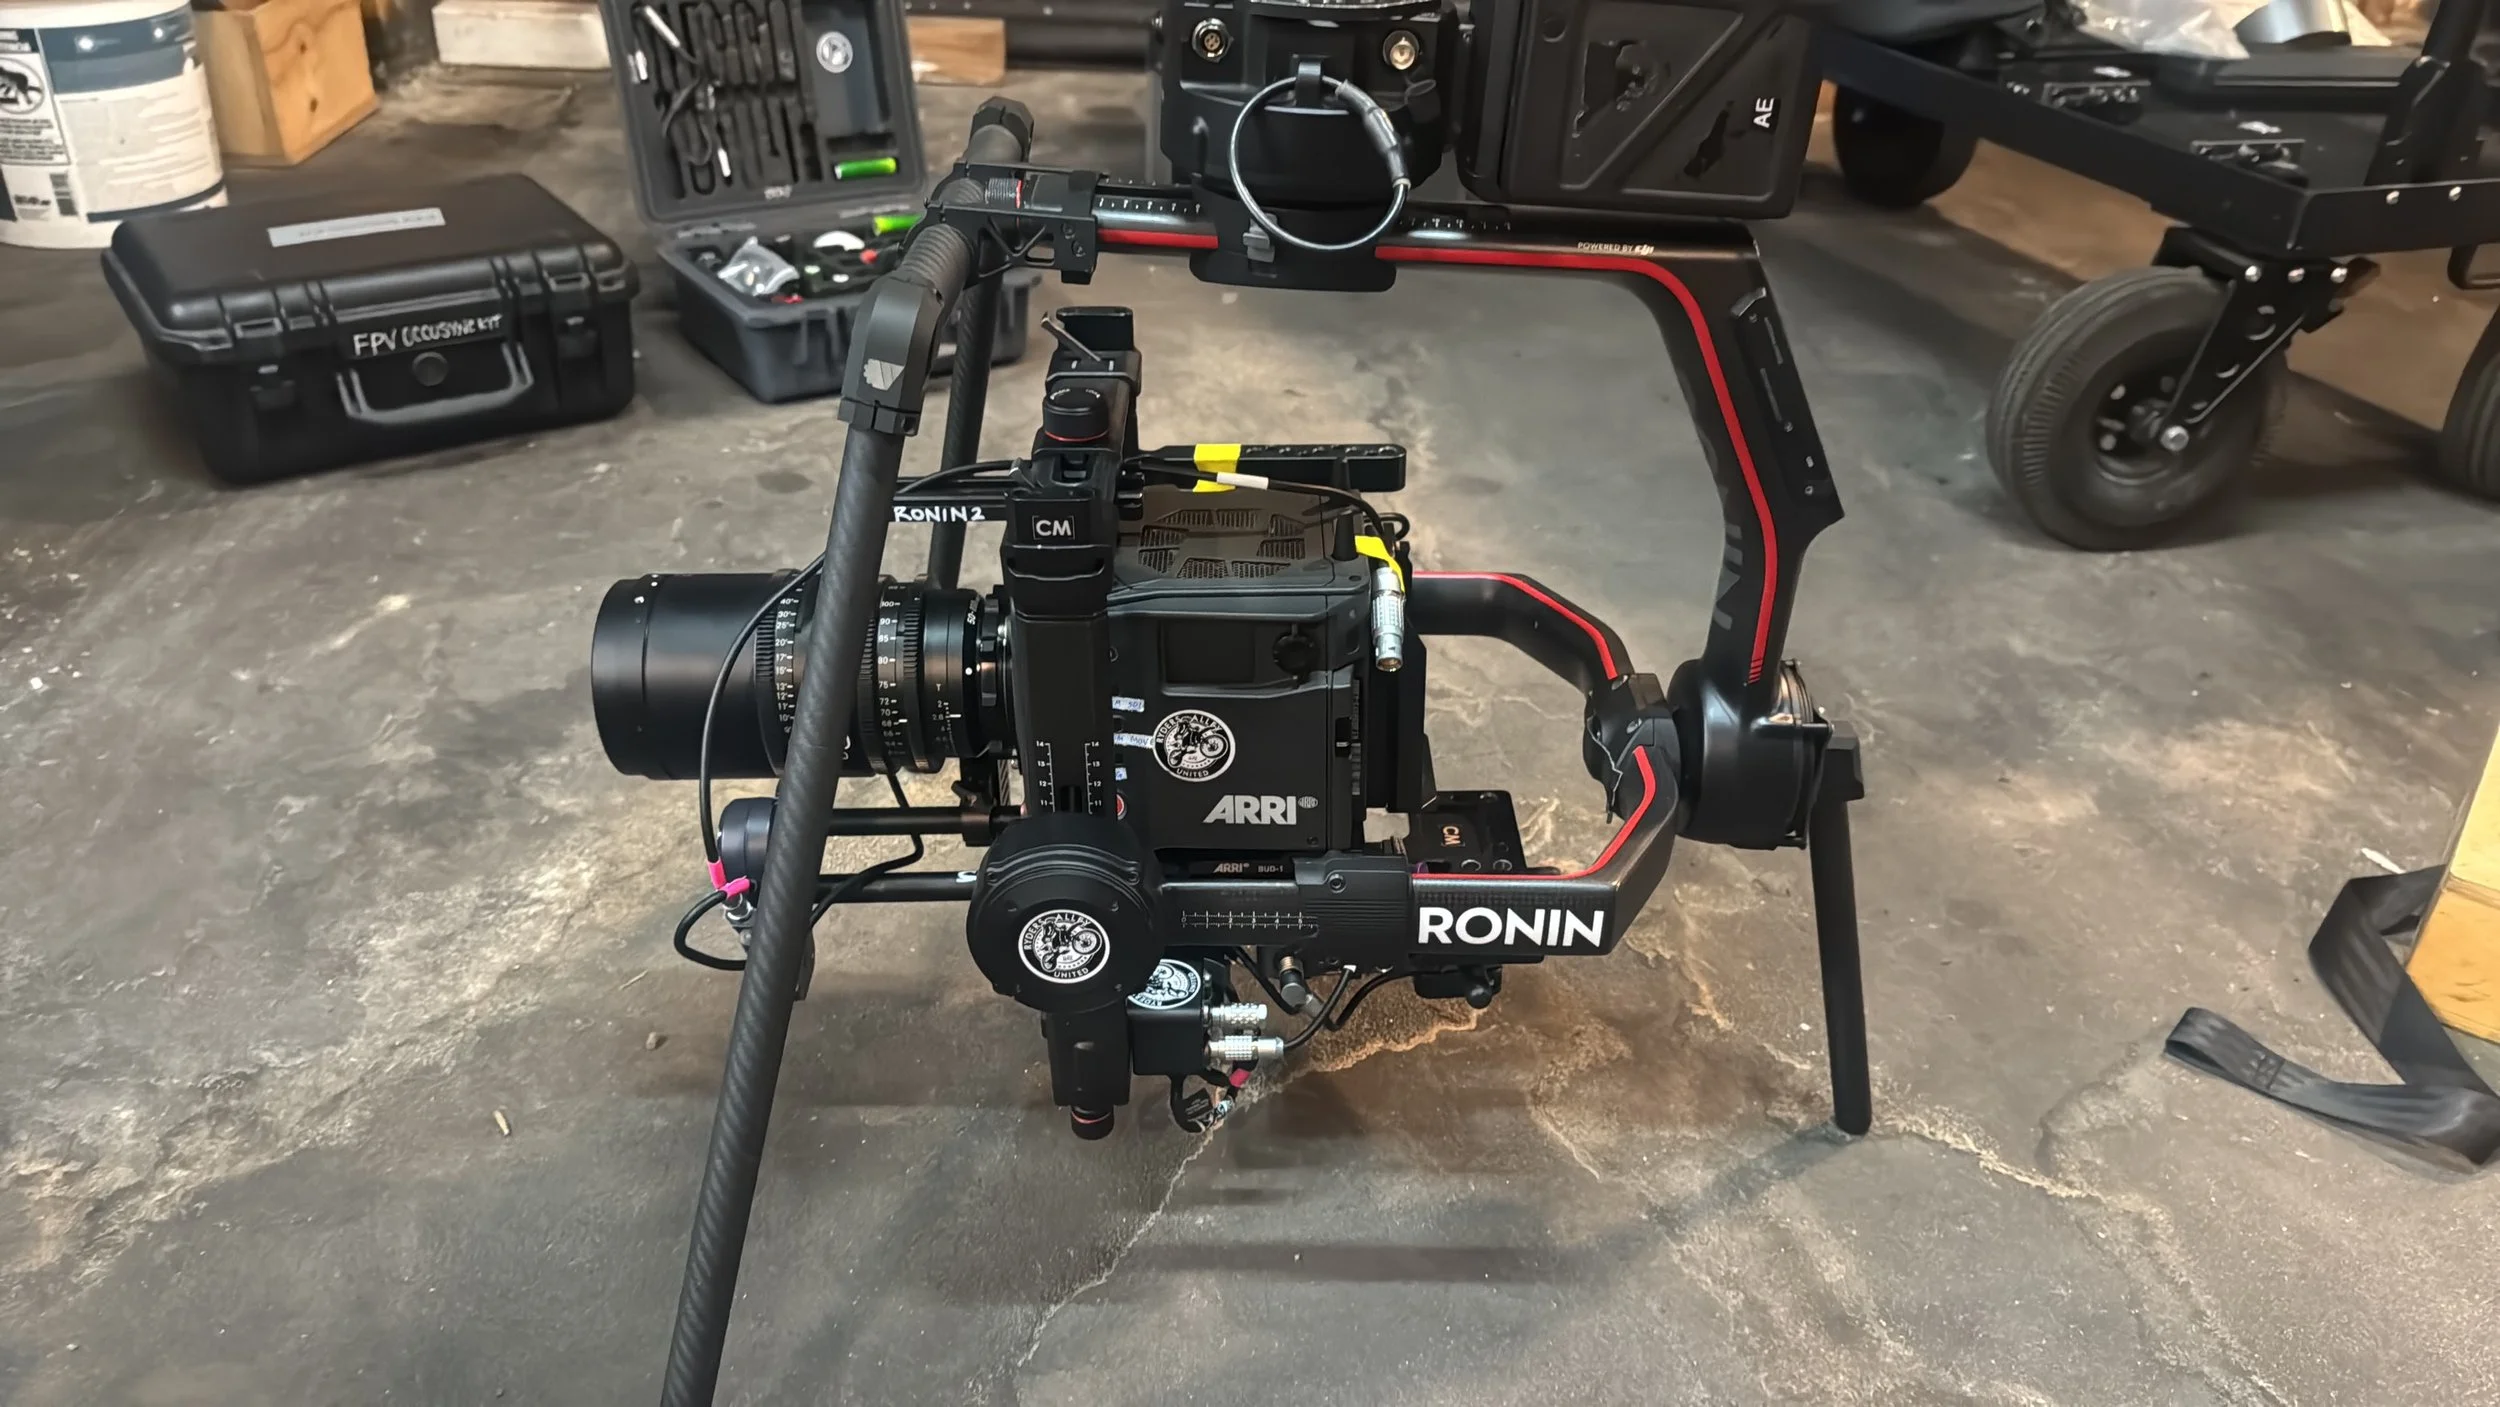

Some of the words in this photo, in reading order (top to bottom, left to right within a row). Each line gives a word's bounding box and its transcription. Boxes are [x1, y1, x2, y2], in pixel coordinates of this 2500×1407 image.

[1753, 97, 1775, 129] AE
[1577, 241, 1620, 251] POWERED
[1622, 244, 1633, 253] BY
[353, 328, 397, 356] FPV
[893, 506, 968, 523] RONIN
[1035, 519, 1072, 537] CM
[879, 681, 889, 689] 75
[880, 697, 890, 705] 72
[1155, 714, 1181, 744] RYDERS
[1191, 713, 1223, 733] ALLEY
[1176, 768, 1209, 779] UNITED
[1202, 795, 1297, 826] ARRI
[1442, 825, 1461, 846] CM
[1213, 862, 1243, 874] ARRI
[1258, 865, 1284, 873] BUD-1
[1023, 918, 1046, 951] RYDERS
[1055, 913, 1091, 927] ALLEY
[1418, 906, 1605, 948] RONIN
[1054, 968, 1089, 979] UNITED
